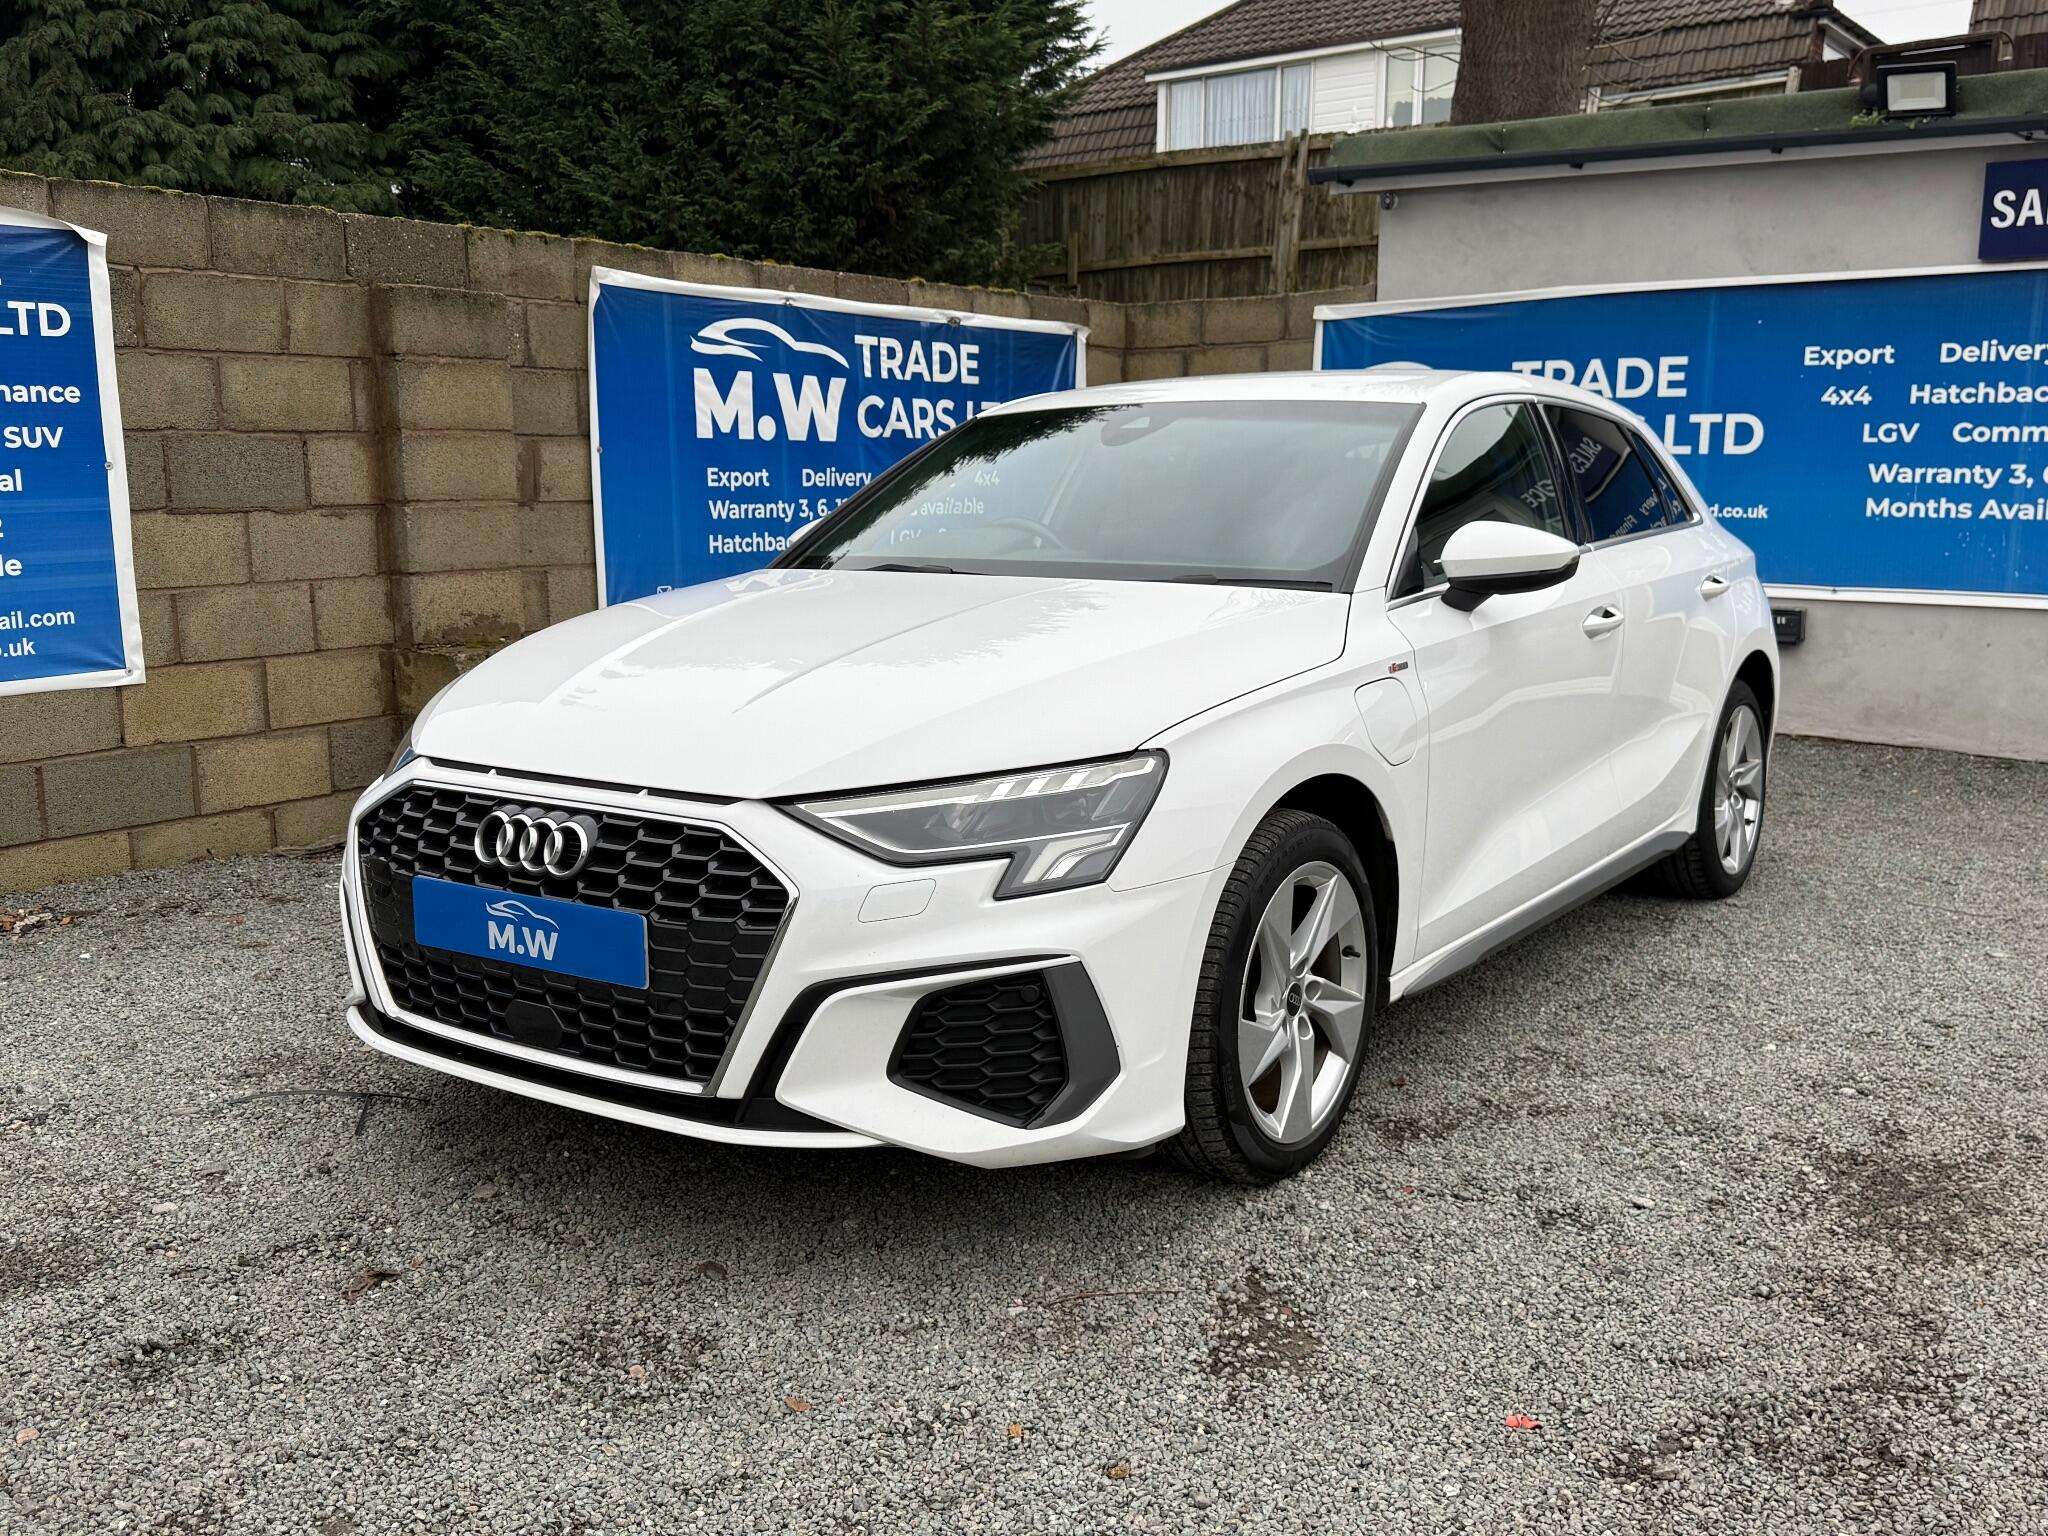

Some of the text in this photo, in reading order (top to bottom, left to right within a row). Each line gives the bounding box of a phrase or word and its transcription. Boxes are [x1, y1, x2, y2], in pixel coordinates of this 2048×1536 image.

[1990, 188, 2048, 229] SA
[0, 300, 71, 337] TD
[854, 334, 980, 385] TRADE
[1803, 345, 1895, 370] Export
[693, 368, 847, 442] M.W
[1820, 385, 1872, 406] 4x4
[857, 394, 958, 440] CARS
[3, 426, 64, 449] SUV
[1664, 412, 1765, 456] LTD
[1862, 422, 1920, 444] LGV
[706, 466, 1000, 492] Export Delivery 4x4
[1868, 462, 2003, 489] Warranty
[2008, 463, 2034, 489] 3,
[708, 499, 796, 524] Warranty
[798, 498, 814, 521] 3,
[921, 497, 985, 516] available
[1865, 497, 2048, 521] Months Avai
[488, 920, 558, 961] M.W
